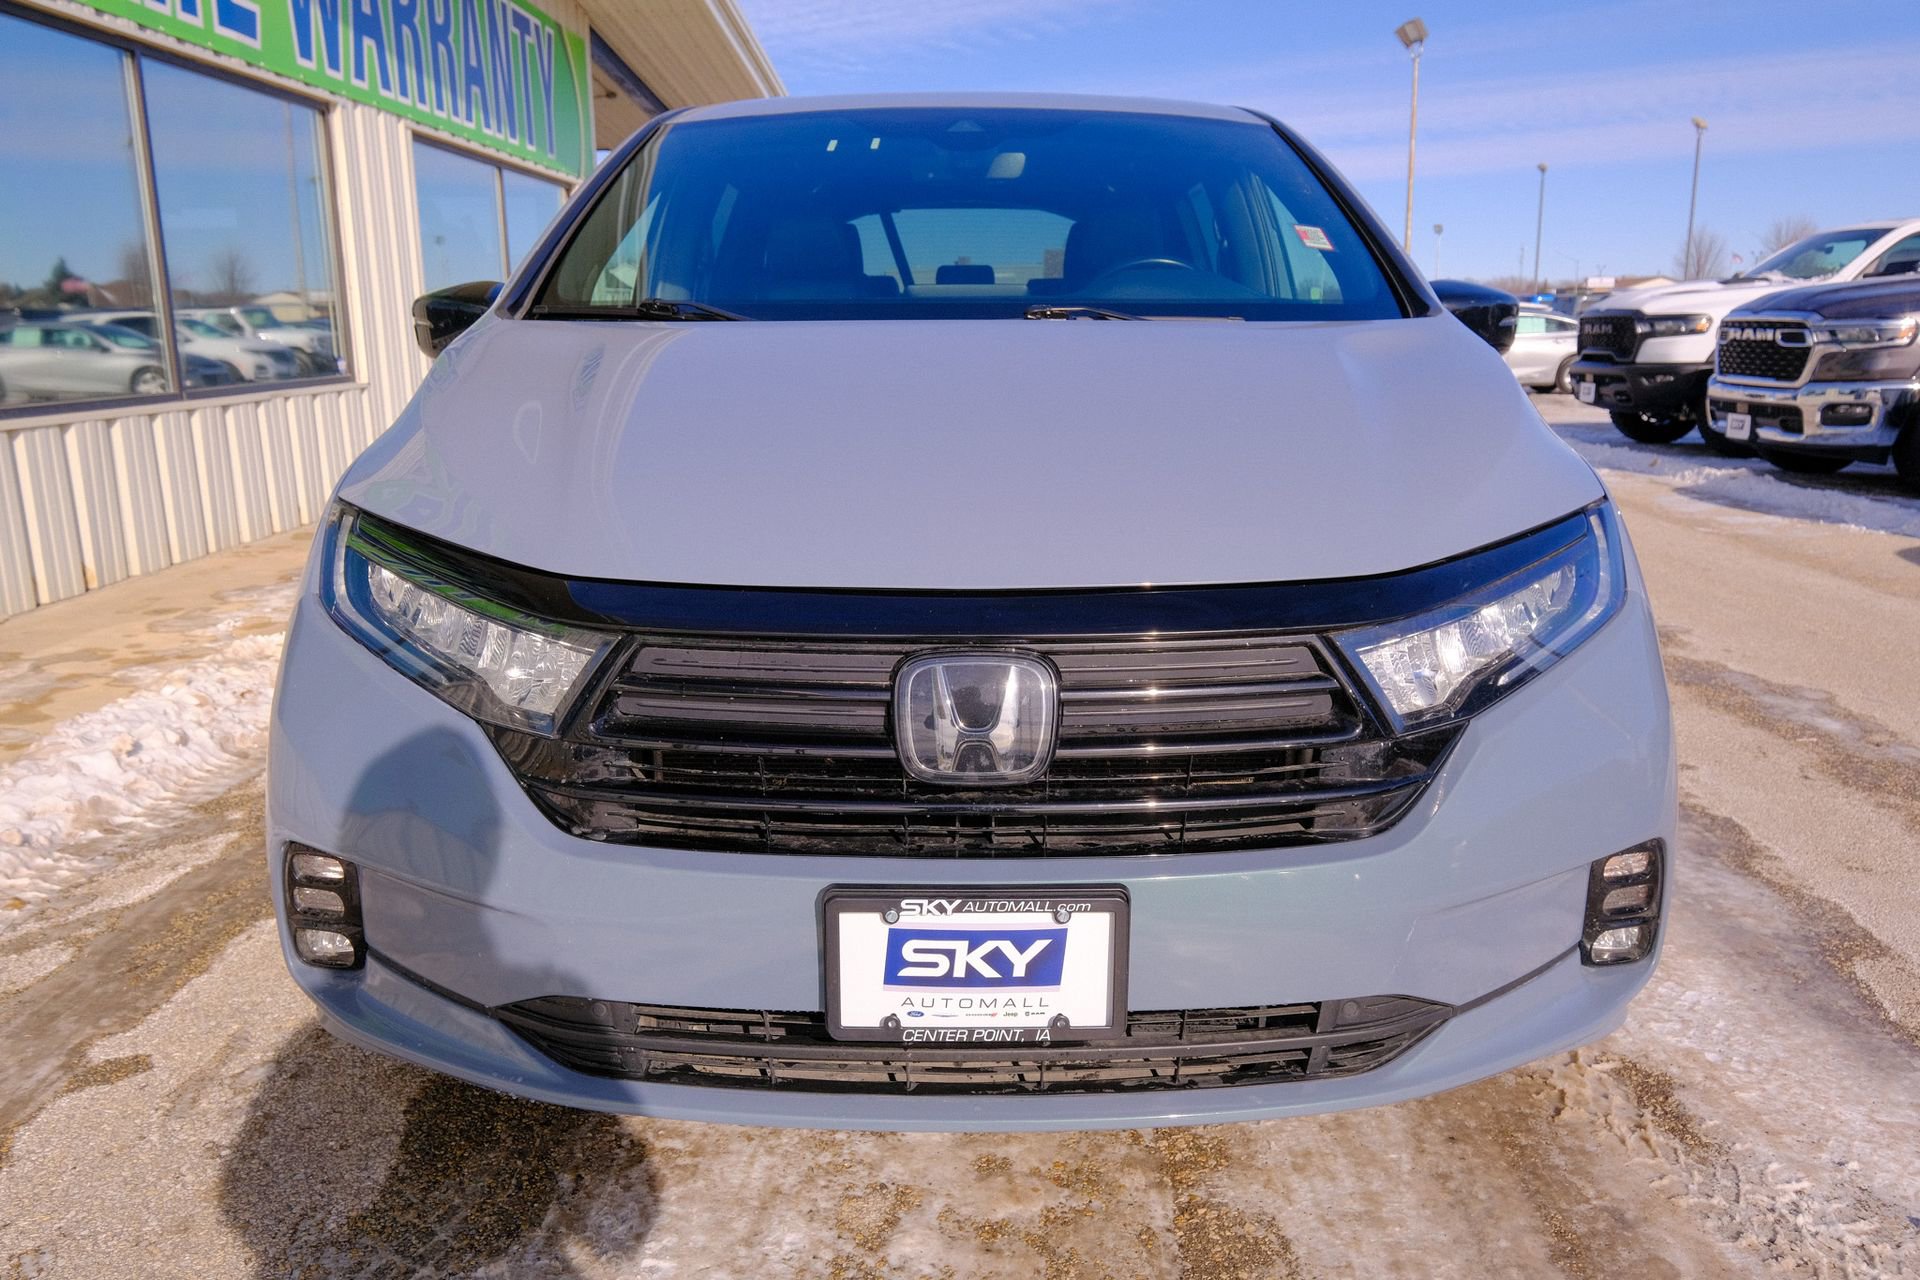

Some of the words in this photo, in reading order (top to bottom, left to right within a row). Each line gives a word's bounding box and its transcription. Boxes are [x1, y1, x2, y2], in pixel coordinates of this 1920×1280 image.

[1583, 324, 1613, 334] RAM
[1728, 328, 1774, 341] RAM
[900, 899, 962, 915] SKY
[963, 901, 1091, 912] AUTOMALL.com
[897, 939, 1053, 978] SKY
[901, 997, 1049, 1009] AUTOMALL
[903, 1029, 968, 1042] CENTER
[973, 1029, 1025, 1042] POINT,
[1036, 1029, 1051, 1041] IA
